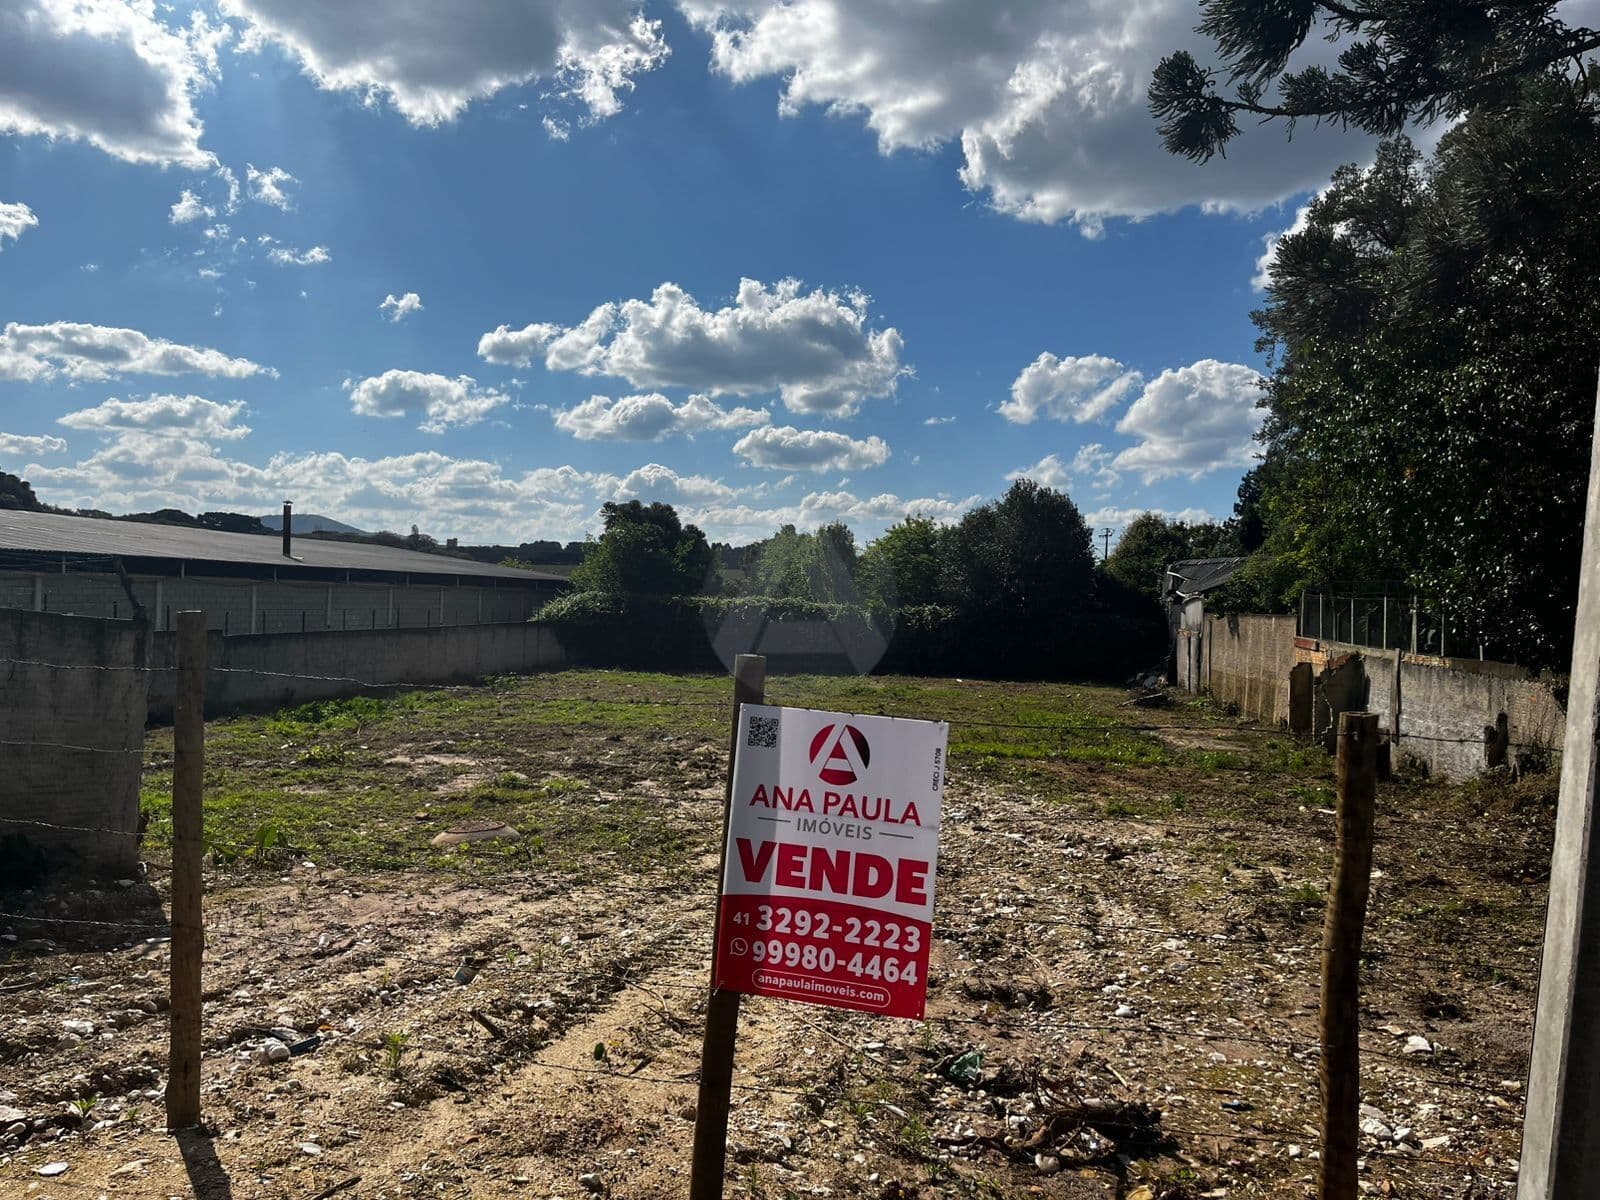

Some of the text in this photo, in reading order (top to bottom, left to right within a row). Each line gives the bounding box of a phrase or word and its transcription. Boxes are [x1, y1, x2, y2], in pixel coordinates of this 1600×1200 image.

[932, 771, 940, 791] CRECI
[749, 784, 921, 827] ANA PAULA
[797, 817, 872, 840] IMÓVEIS
[736, 838, 929, 905] VENDE
[733, 905, 920, 952] 41 3292-2223
[752, 940, 918, 985] 99980-4464
[758, 974, 885, 1002] anapaulaimoveis.com
